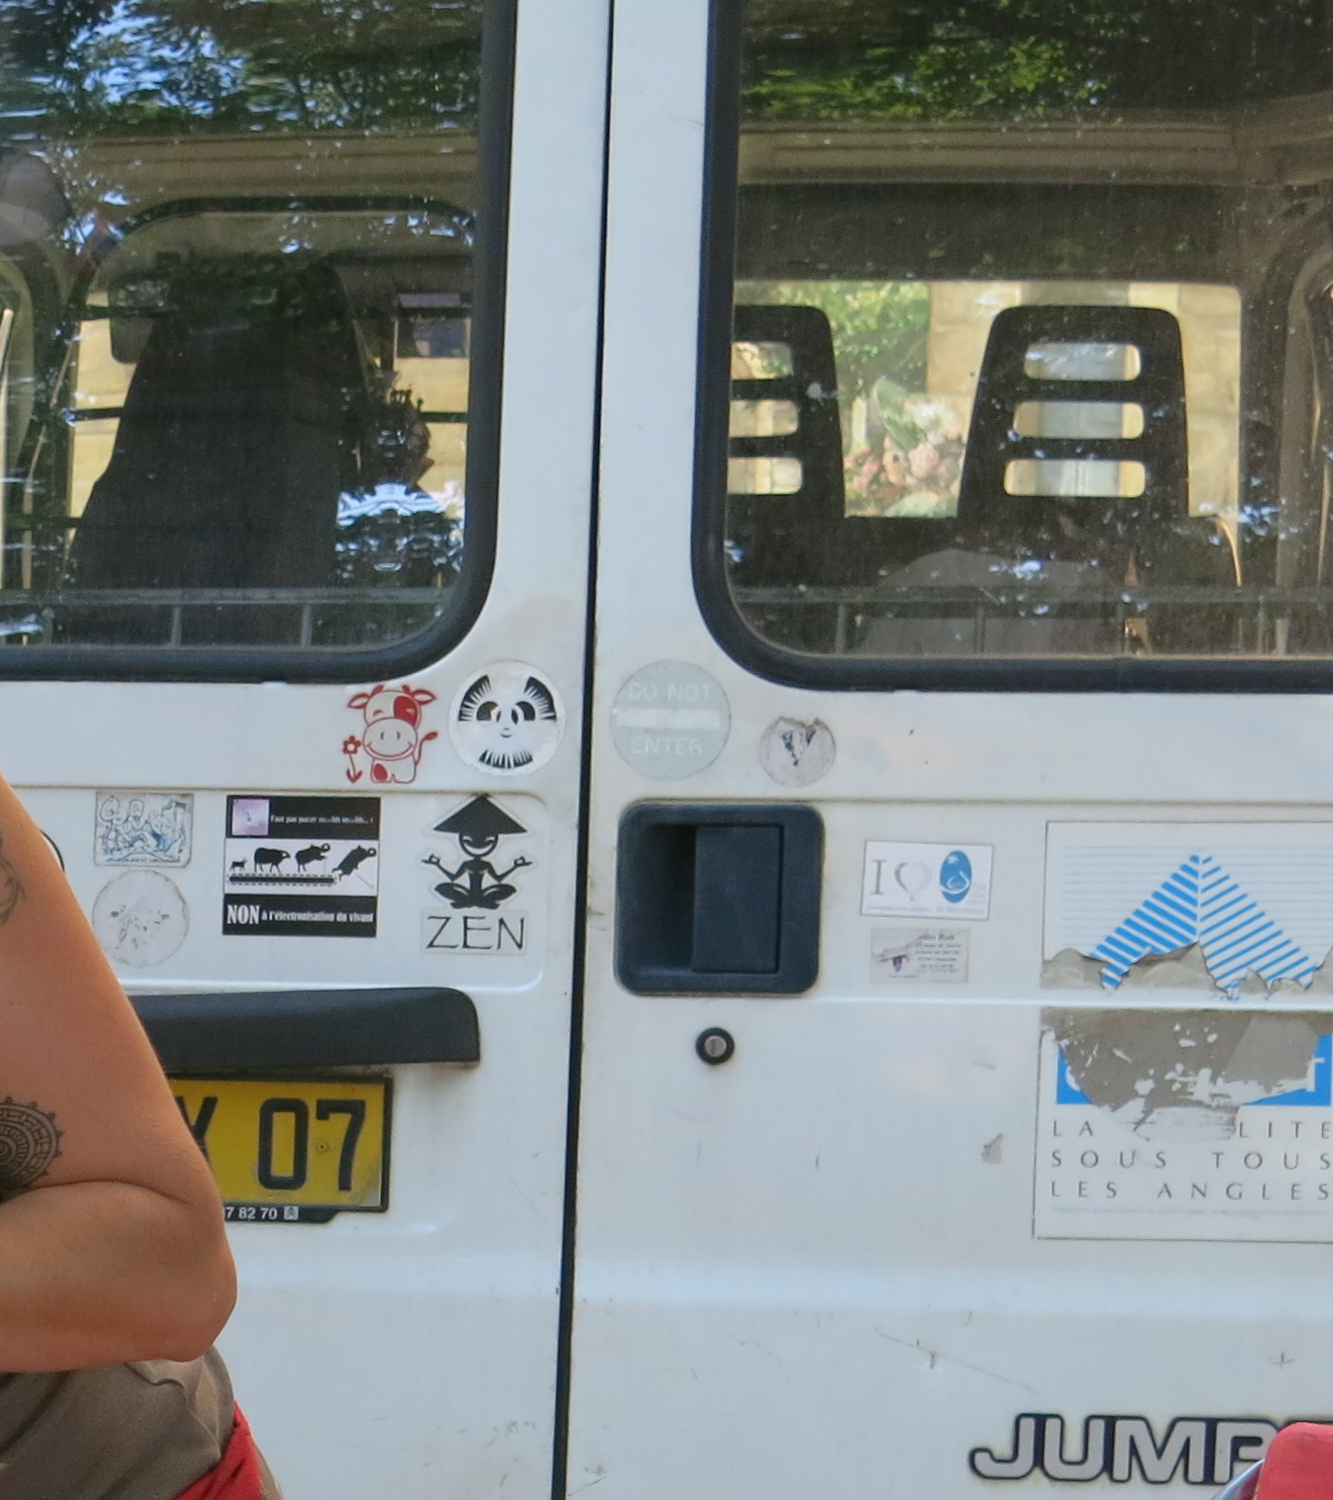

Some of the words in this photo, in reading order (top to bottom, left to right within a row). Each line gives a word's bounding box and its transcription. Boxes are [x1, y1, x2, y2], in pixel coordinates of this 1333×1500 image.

[667, 684, 711, 700] NOT
[631, 737, 703, 756] ENTER
[226, 904, 260, 925] NON
[336, 912, 347, 922] du
[349, 912, 374, 922] vivant
[426, 915, 525, 950] ZEN
[1052, 1120, 1094, 1138] LA
[258, 1097, 367, 1192] 07
[1051, 1150, 1167, 1169] SOUS
[1212, 1151, 1331, 1171] TOUS
[1051, 1181, 1117, 1199] LES
[1157, 1182, 1330, 1201] ANGLES
[238, 1207, 256, 1220] 82
[261, 1207, 278, 1220] 70
[969, 1413, 1280, 1486] JUMP
